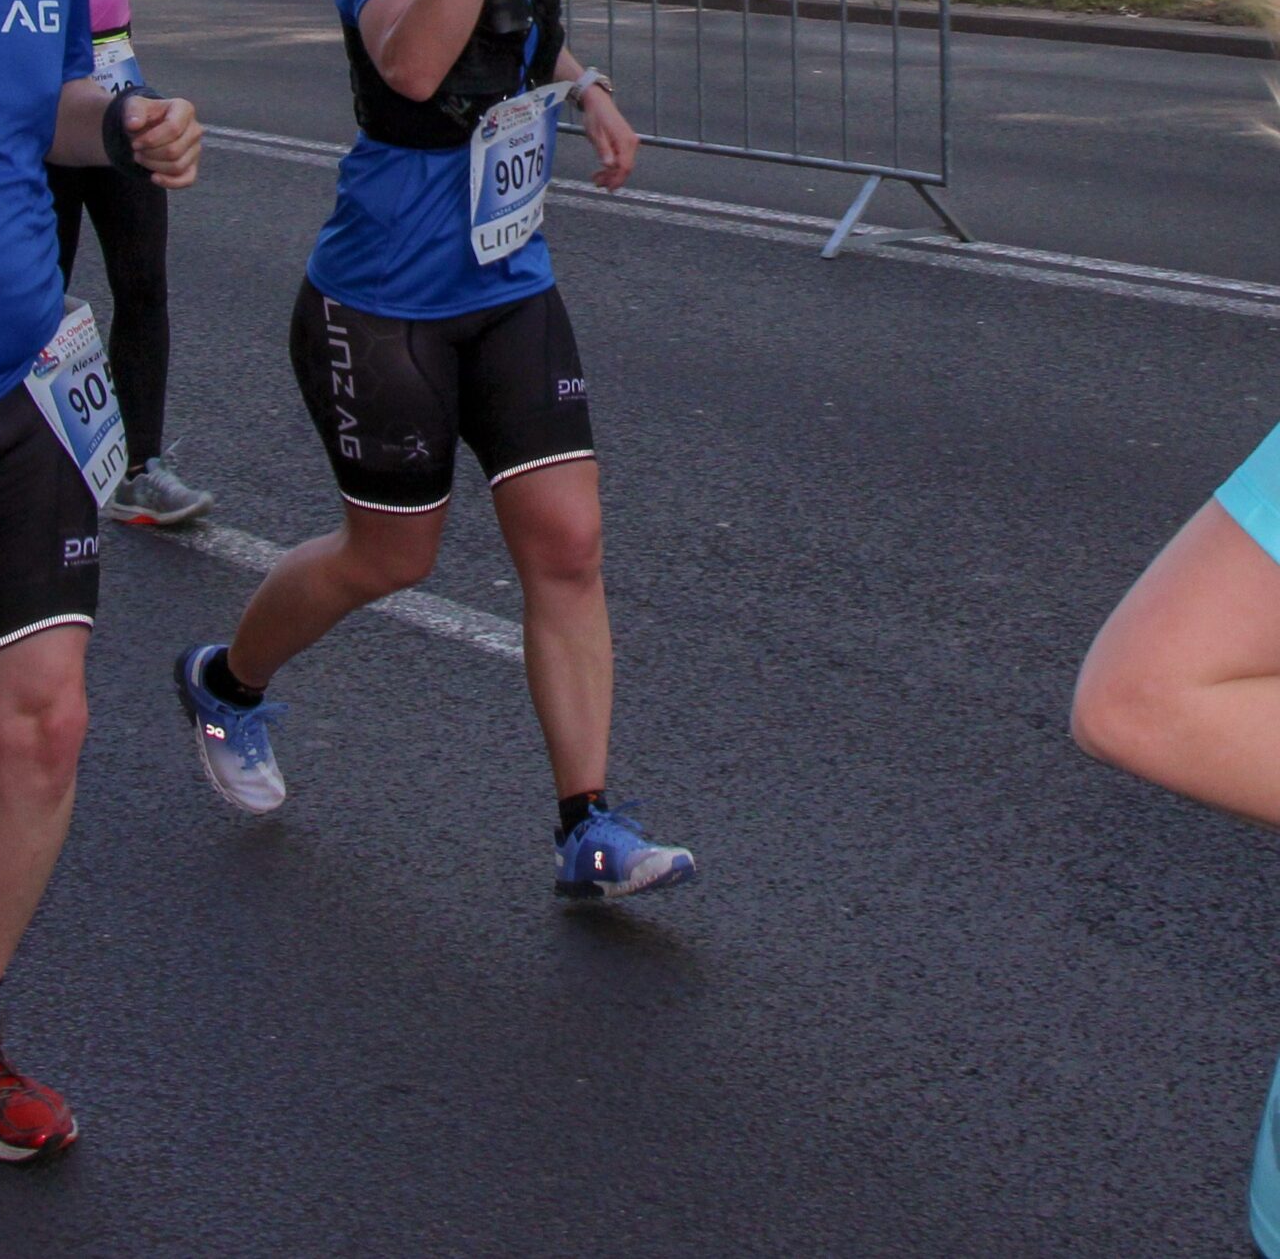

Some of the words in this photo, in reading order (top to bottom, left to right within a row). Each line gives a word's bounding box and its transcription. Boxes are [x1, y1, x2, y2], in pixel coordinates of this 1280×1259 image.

[1, 0, 60, 34] AG
[495, 143, 545, 196] 9076
[335, 405, 363, 460] AG
